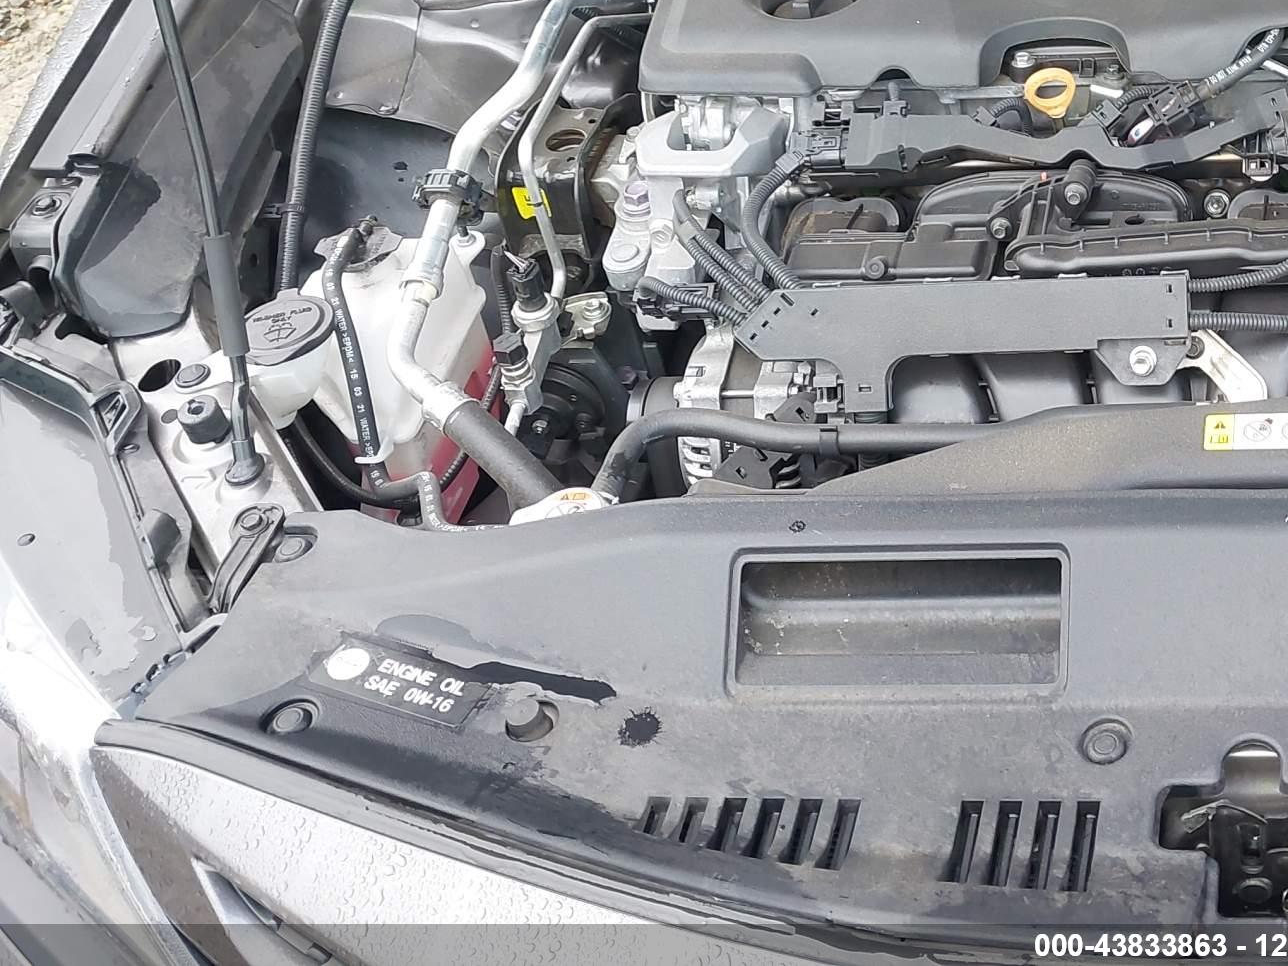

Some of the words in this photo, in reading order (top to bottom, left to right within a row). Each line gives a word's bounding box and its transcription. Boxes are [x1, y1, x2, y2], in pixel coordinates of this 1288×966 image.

[335, 308, 347, 332] WATER
[349, 369, 359, 379] 15
[359, 417, 371, 442] WATER
[363, 674, 401, 696] SAE
[403, 688, 454, 712] 0W-16
[378, 659, 437, 686] ENGINE
[439, 677, 465, 697] OIL
